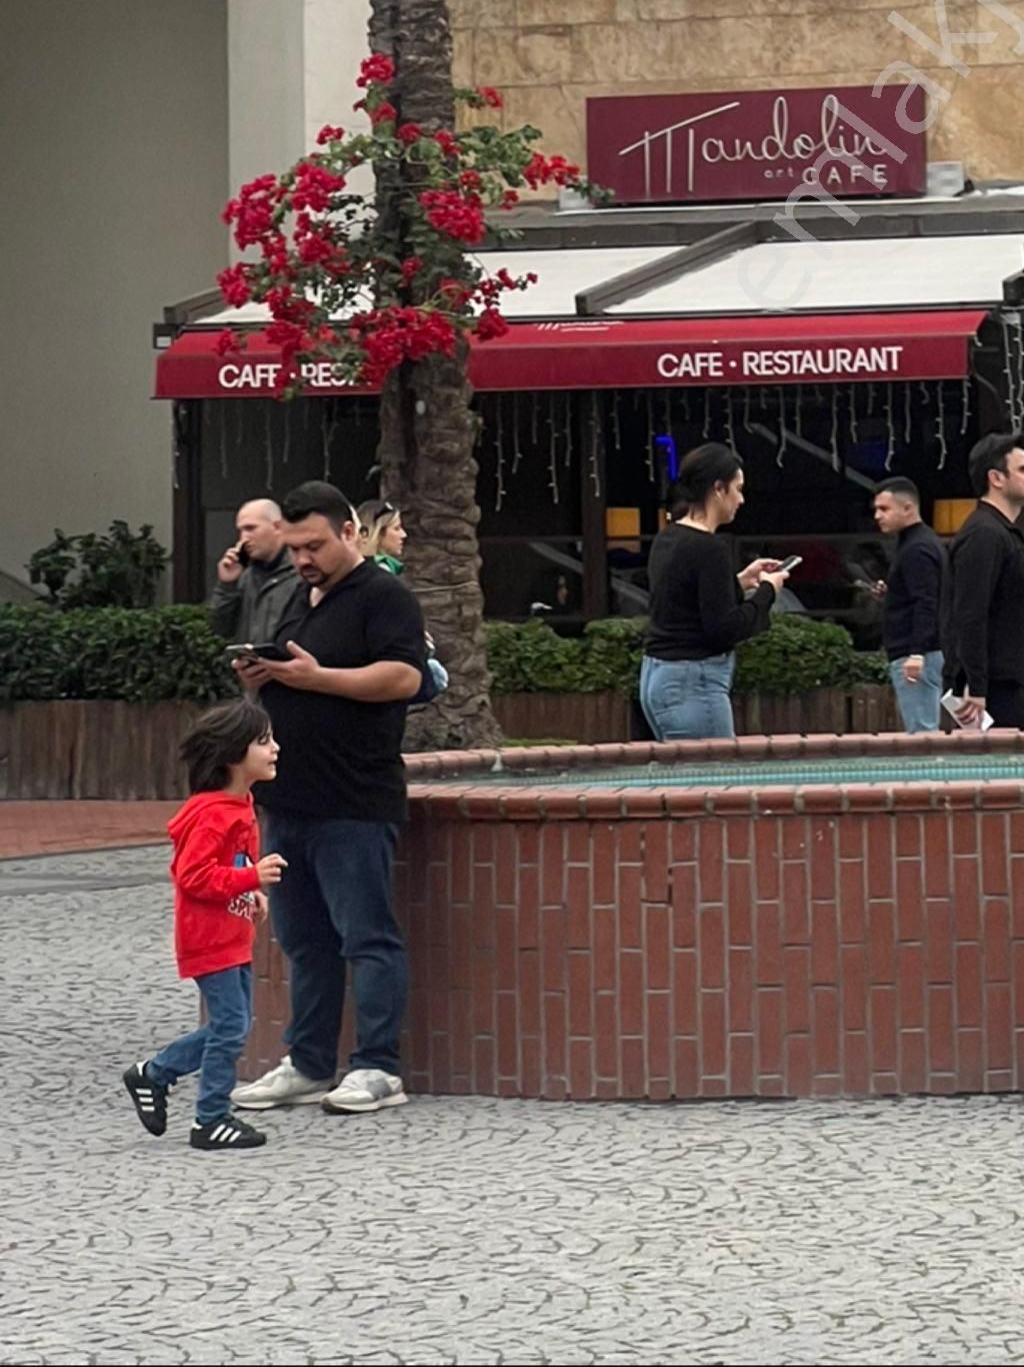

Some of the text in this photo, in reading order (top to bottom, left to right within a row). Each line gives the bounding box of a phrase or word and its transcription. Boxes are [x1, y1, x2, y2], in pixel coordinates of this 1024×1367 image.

[618, 94, 887, 196] Mandolin
[802, 164, 888, 185] CAFE
[657, 346, 903, 378] CAFE RESTAURANT
